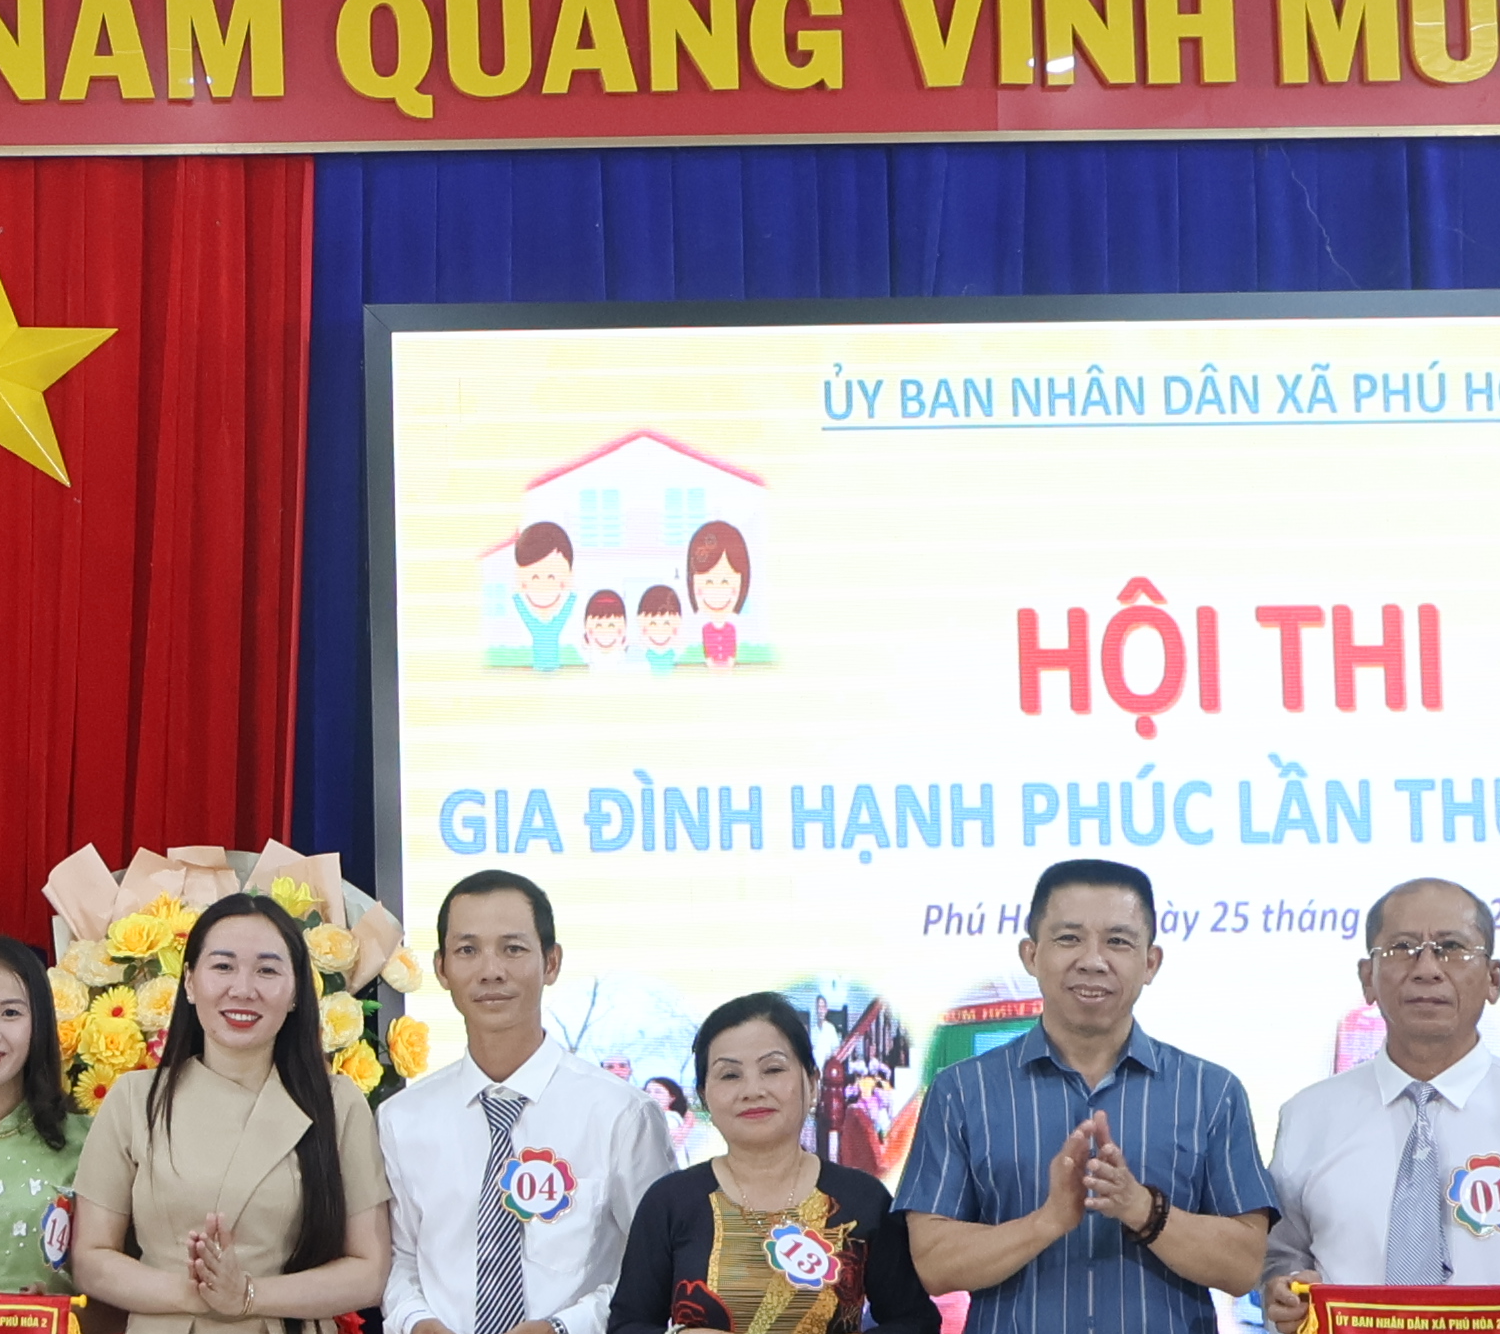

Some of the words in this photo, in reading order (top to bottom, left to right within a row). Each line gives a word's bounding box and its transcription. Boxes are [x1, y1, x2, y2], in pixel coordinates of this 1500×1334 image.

[824, 363, 884, 420] ỦY
[900, 377, 994, 419] BAN
[1011, 365, 1144, 417] NHÂN
[1164, 363, 1268, 415] DÂN
[1278, 362, 1342, 414] XÃ
[1354, 361, 1447, 413] PHÚ
[1016, 576, 1223, 739] HỘI
[1255, 603, 1444, 713] THI
[438, 788, 564, 855] GIA
[584, 769, 764, 854] ĐÌNH
[791, 782, 996, 865] HẠNH
[1022, 764, 1214, 848] PHÚC
[1237, 752, 1372, 844] LẦN
[923, 893, 986, 936] Phú
[1210, 901, 1249, 933] 25
[1262, 899, 1360, 940] tháng
[516, 1172, 558, 1201] 04
[47, 1218, 67, 1252] 14
[780, 1238, 823, 1276] 13
[1352, 1316, 1373, 1327] BAN
[1407, 1317, 1429, 1330] DÂN
[1449, 1318, 1469, 1330] PHÚ
